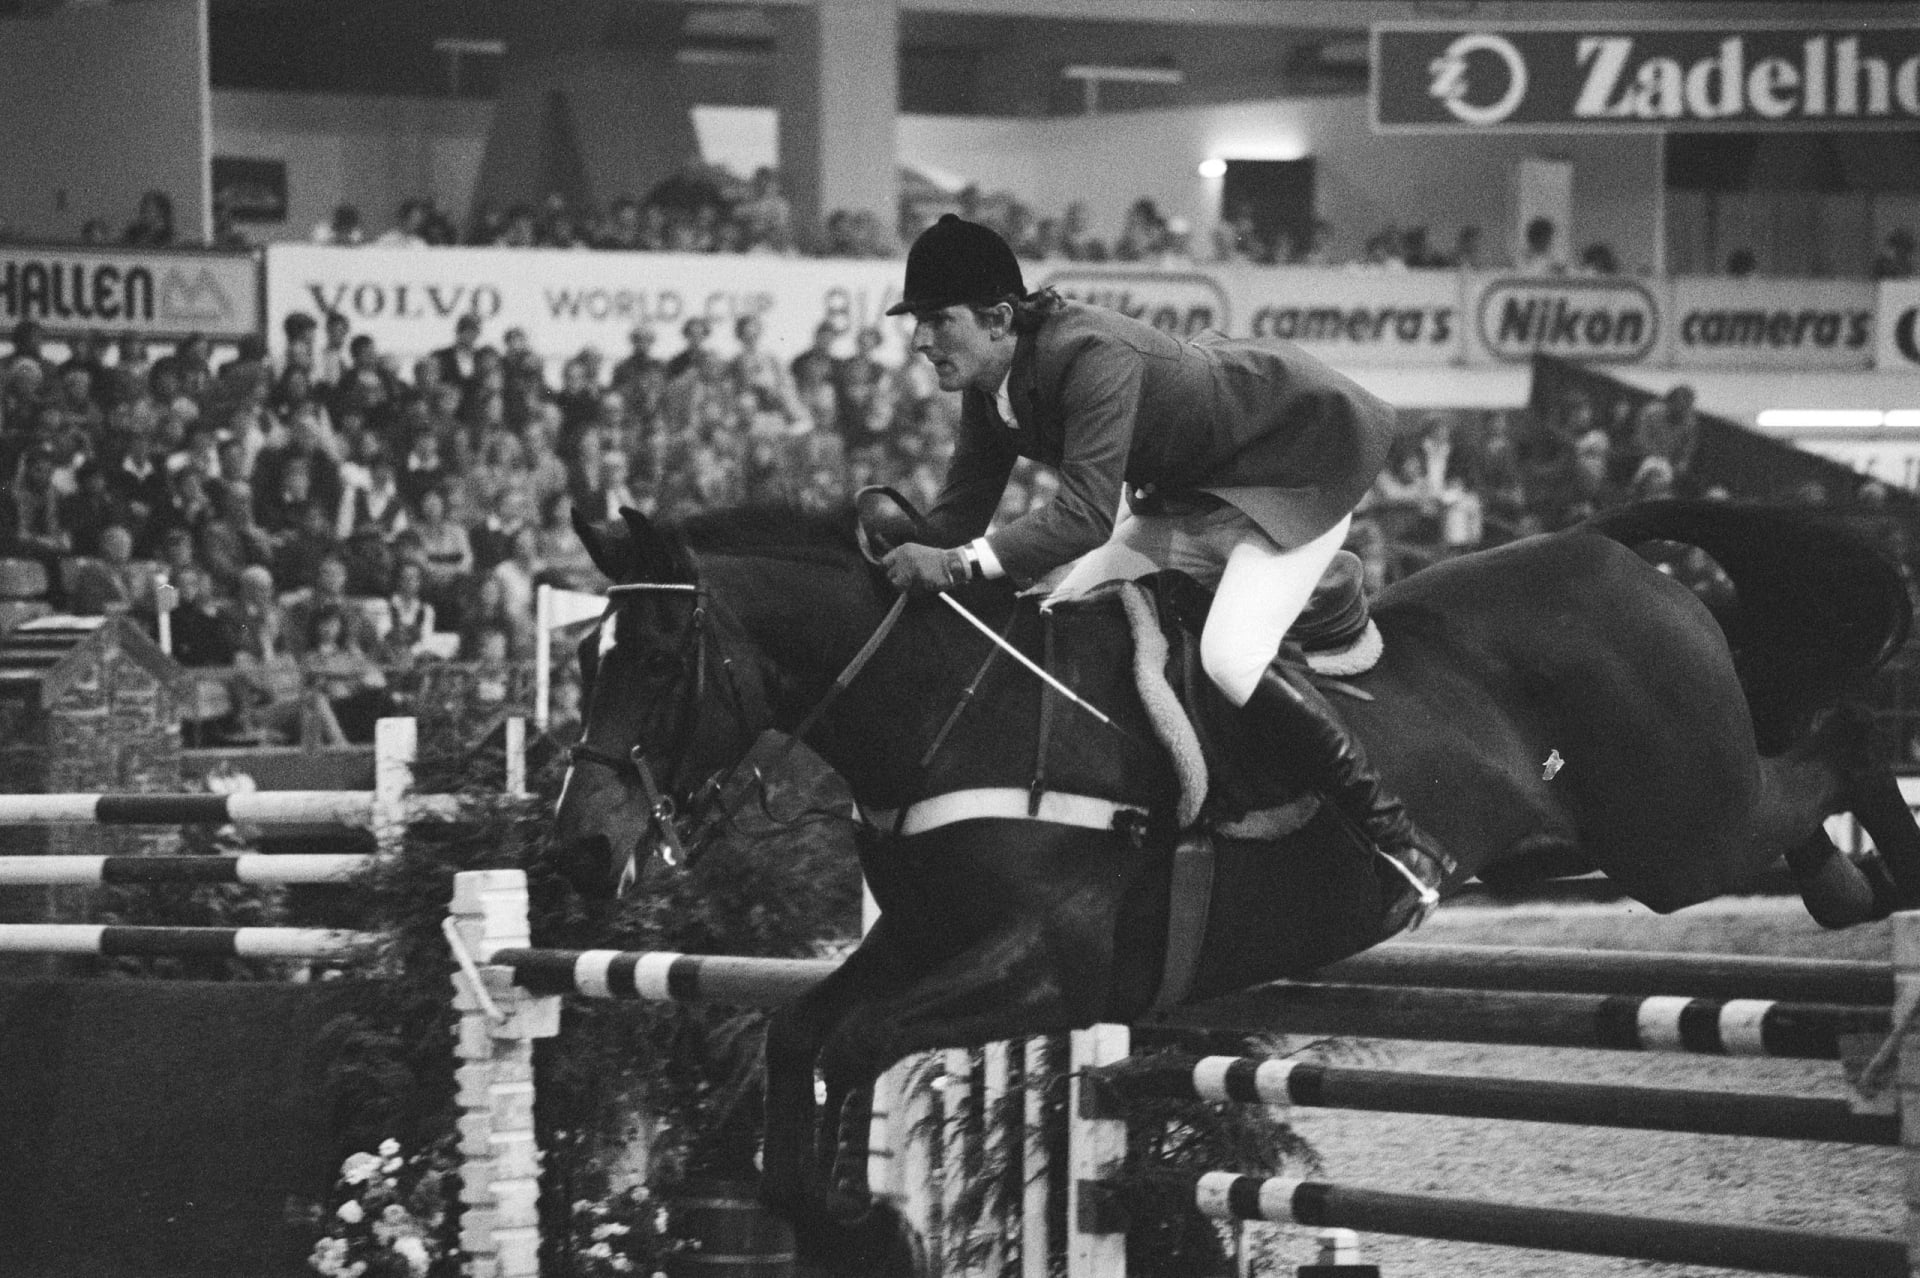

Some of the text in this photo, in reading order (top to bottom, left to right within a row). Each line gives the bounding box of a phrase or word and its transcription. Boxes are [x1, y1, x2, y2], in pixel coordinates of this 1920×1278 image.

[305, 281, 502, 319] VOLVO
[543, 289, 683, 322] WORLD
[1251, 305, 1450, 344] cameras
[1499, 297, 1645, 345] Nikon
[1680, 308, 1870, 349] cameras
